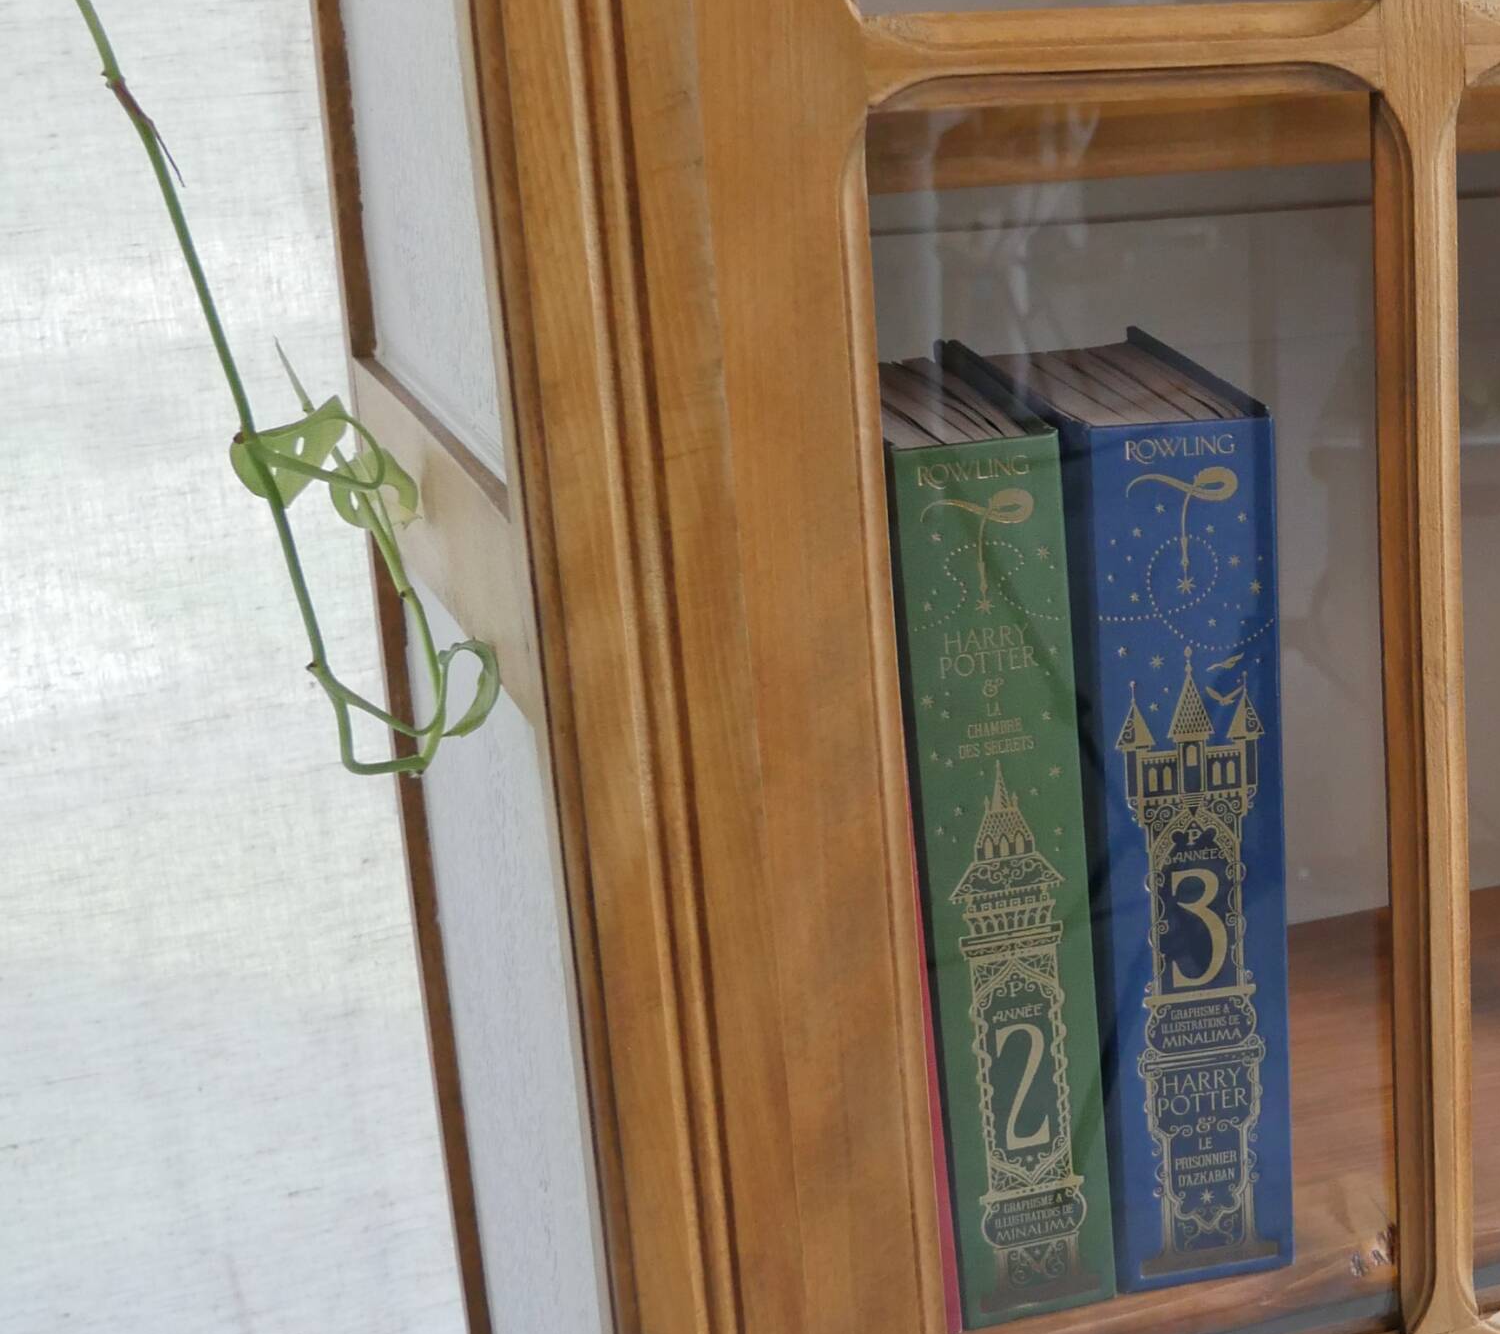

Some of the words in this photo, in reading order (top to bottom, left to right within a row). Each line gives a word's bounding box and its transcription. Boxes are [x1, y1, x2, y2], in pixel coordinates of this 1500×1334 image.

[1125, 433, 1235, 464] ROWLING
[917, 454, 1029, 489] ROWLING
[944, 623, 1028, 655] HARRY
[940, 646, 1040, 679] POTTER
[1170, 868, 1228, 990] 3
[1161, 1017, 1228, 1035] ILLUSTRATIONS
[1170, 1004, 1221, 1021] GRAPHISME
[1162, 1028, 1242, 1049] MINALIMA
[996, 1023, 1051, 1151] 2
[1162, 1067, 1241, 1096] HARRY
[1158, 1087, 1249, 1118] POTTER
[1199, 1137, 1213, 1150] LE
[1175, 1150, 1238, 1170] PRISONNIER
[996, 1216, 1076, 1243] MINALIMA
